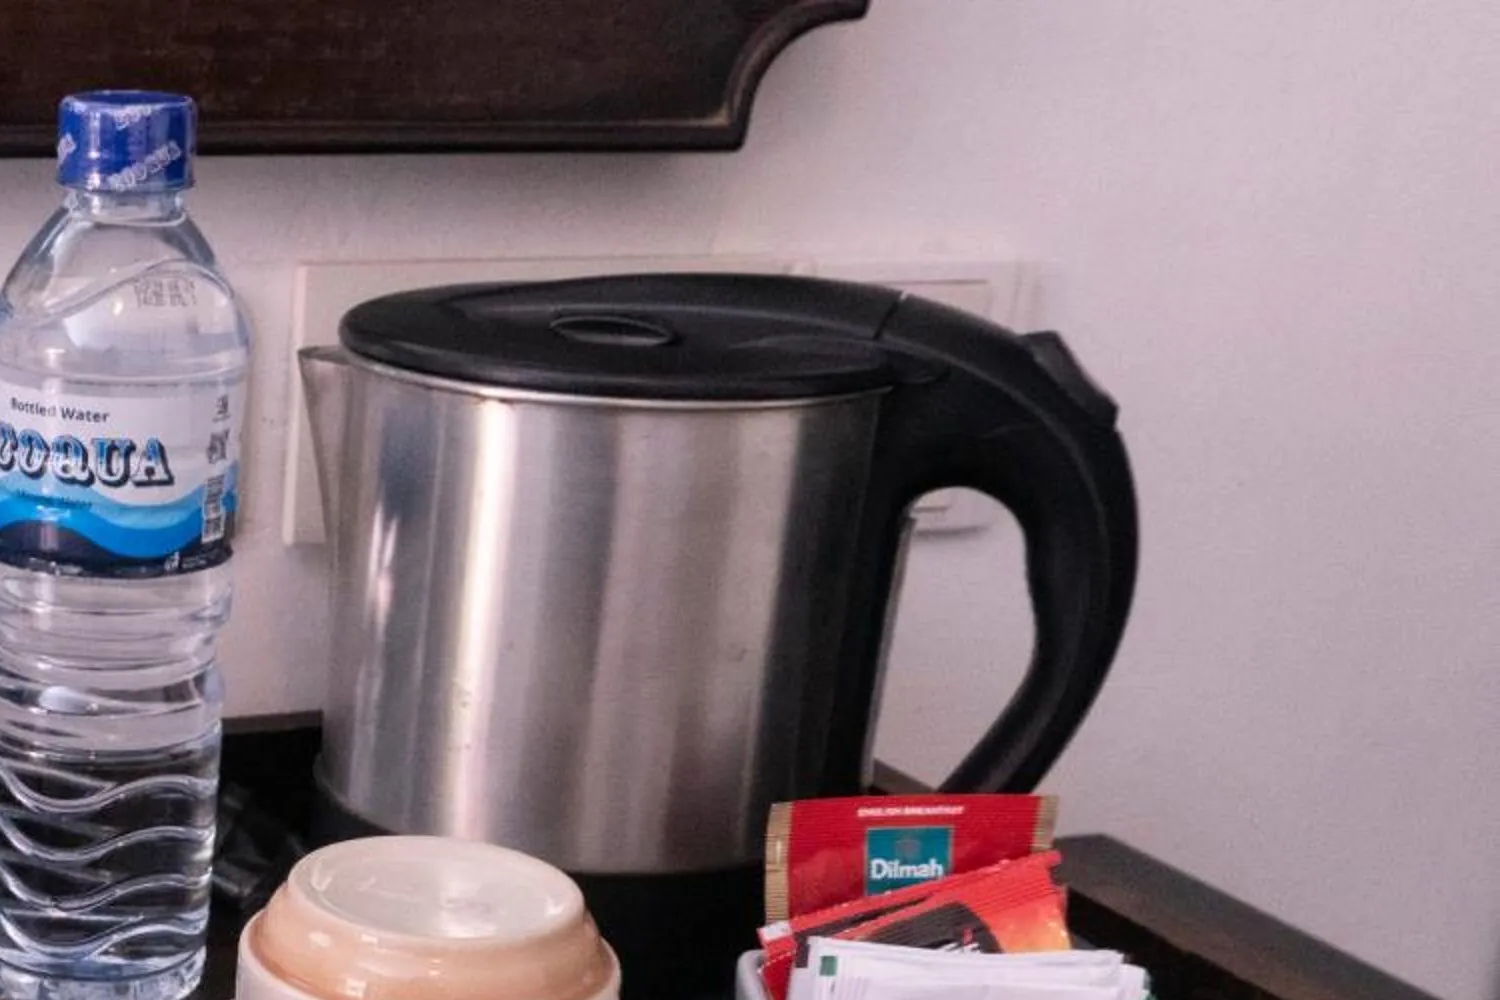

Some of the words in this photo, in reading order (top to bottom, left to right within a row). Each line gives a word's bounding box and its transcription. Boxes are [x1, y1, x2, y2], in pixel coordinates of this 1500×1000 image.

[10, 397, 57, 418] Bottled
[60, 407, 110, 423] Water
[869, 857, 945, 880] Dilmah
